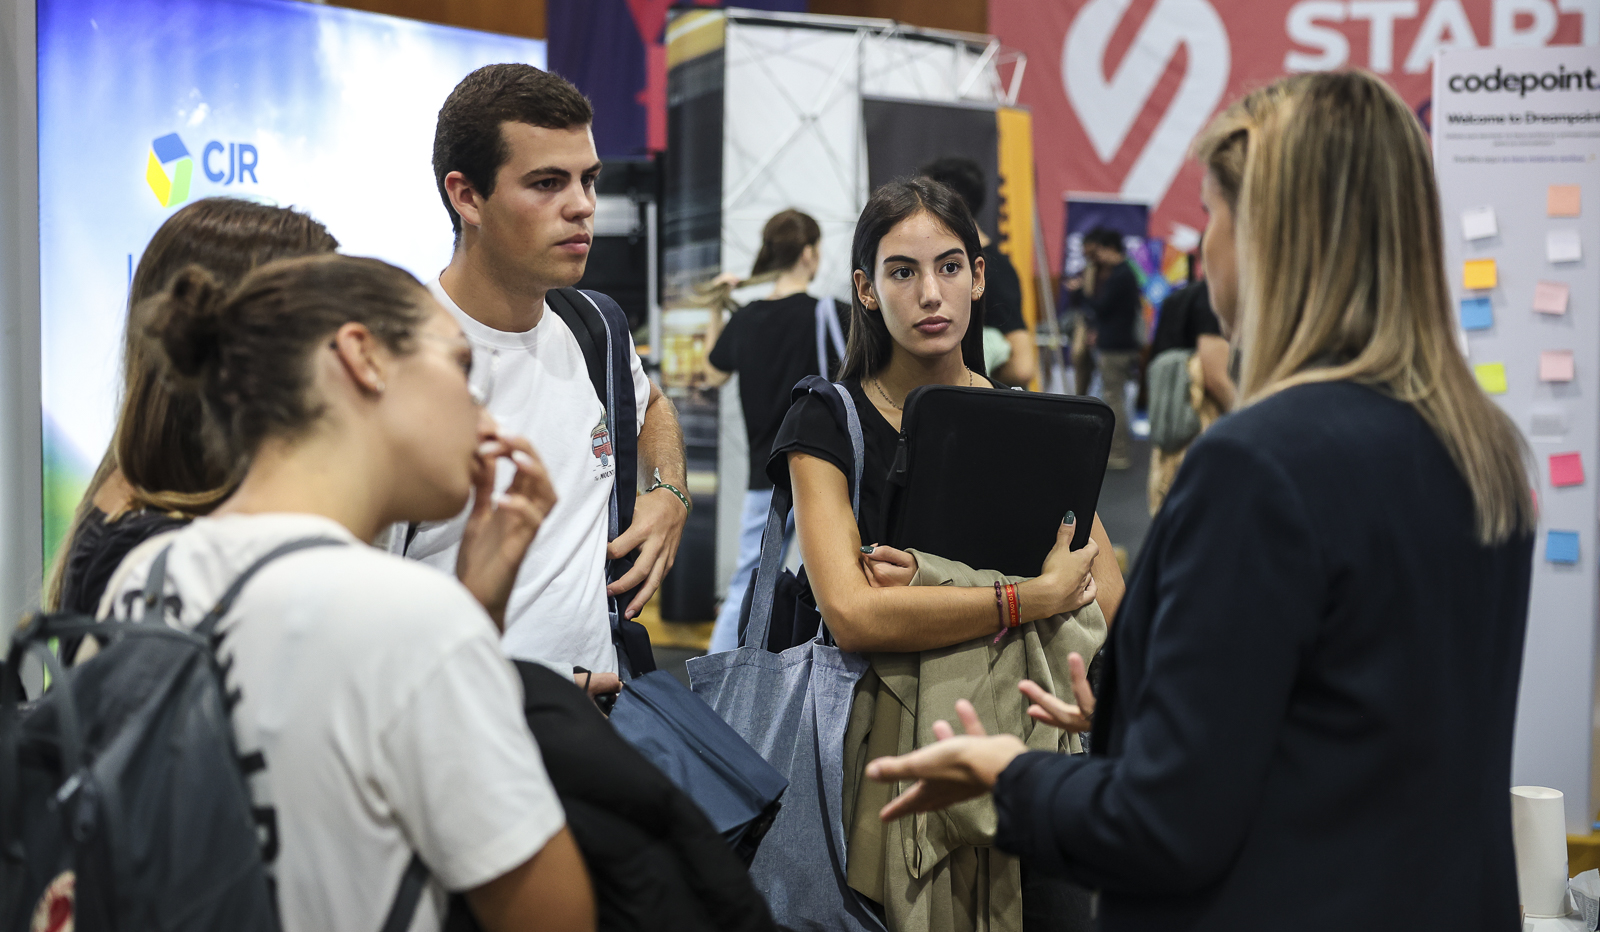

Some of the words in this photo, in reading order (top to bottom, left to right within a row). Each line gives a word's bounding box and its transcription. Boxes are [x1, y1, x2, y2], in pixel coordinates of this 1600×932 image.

[1447, 112, 1505, 126] Welcome
[1508, 113, 1522, 125] to
[203, 140, 258, 186] CJR
